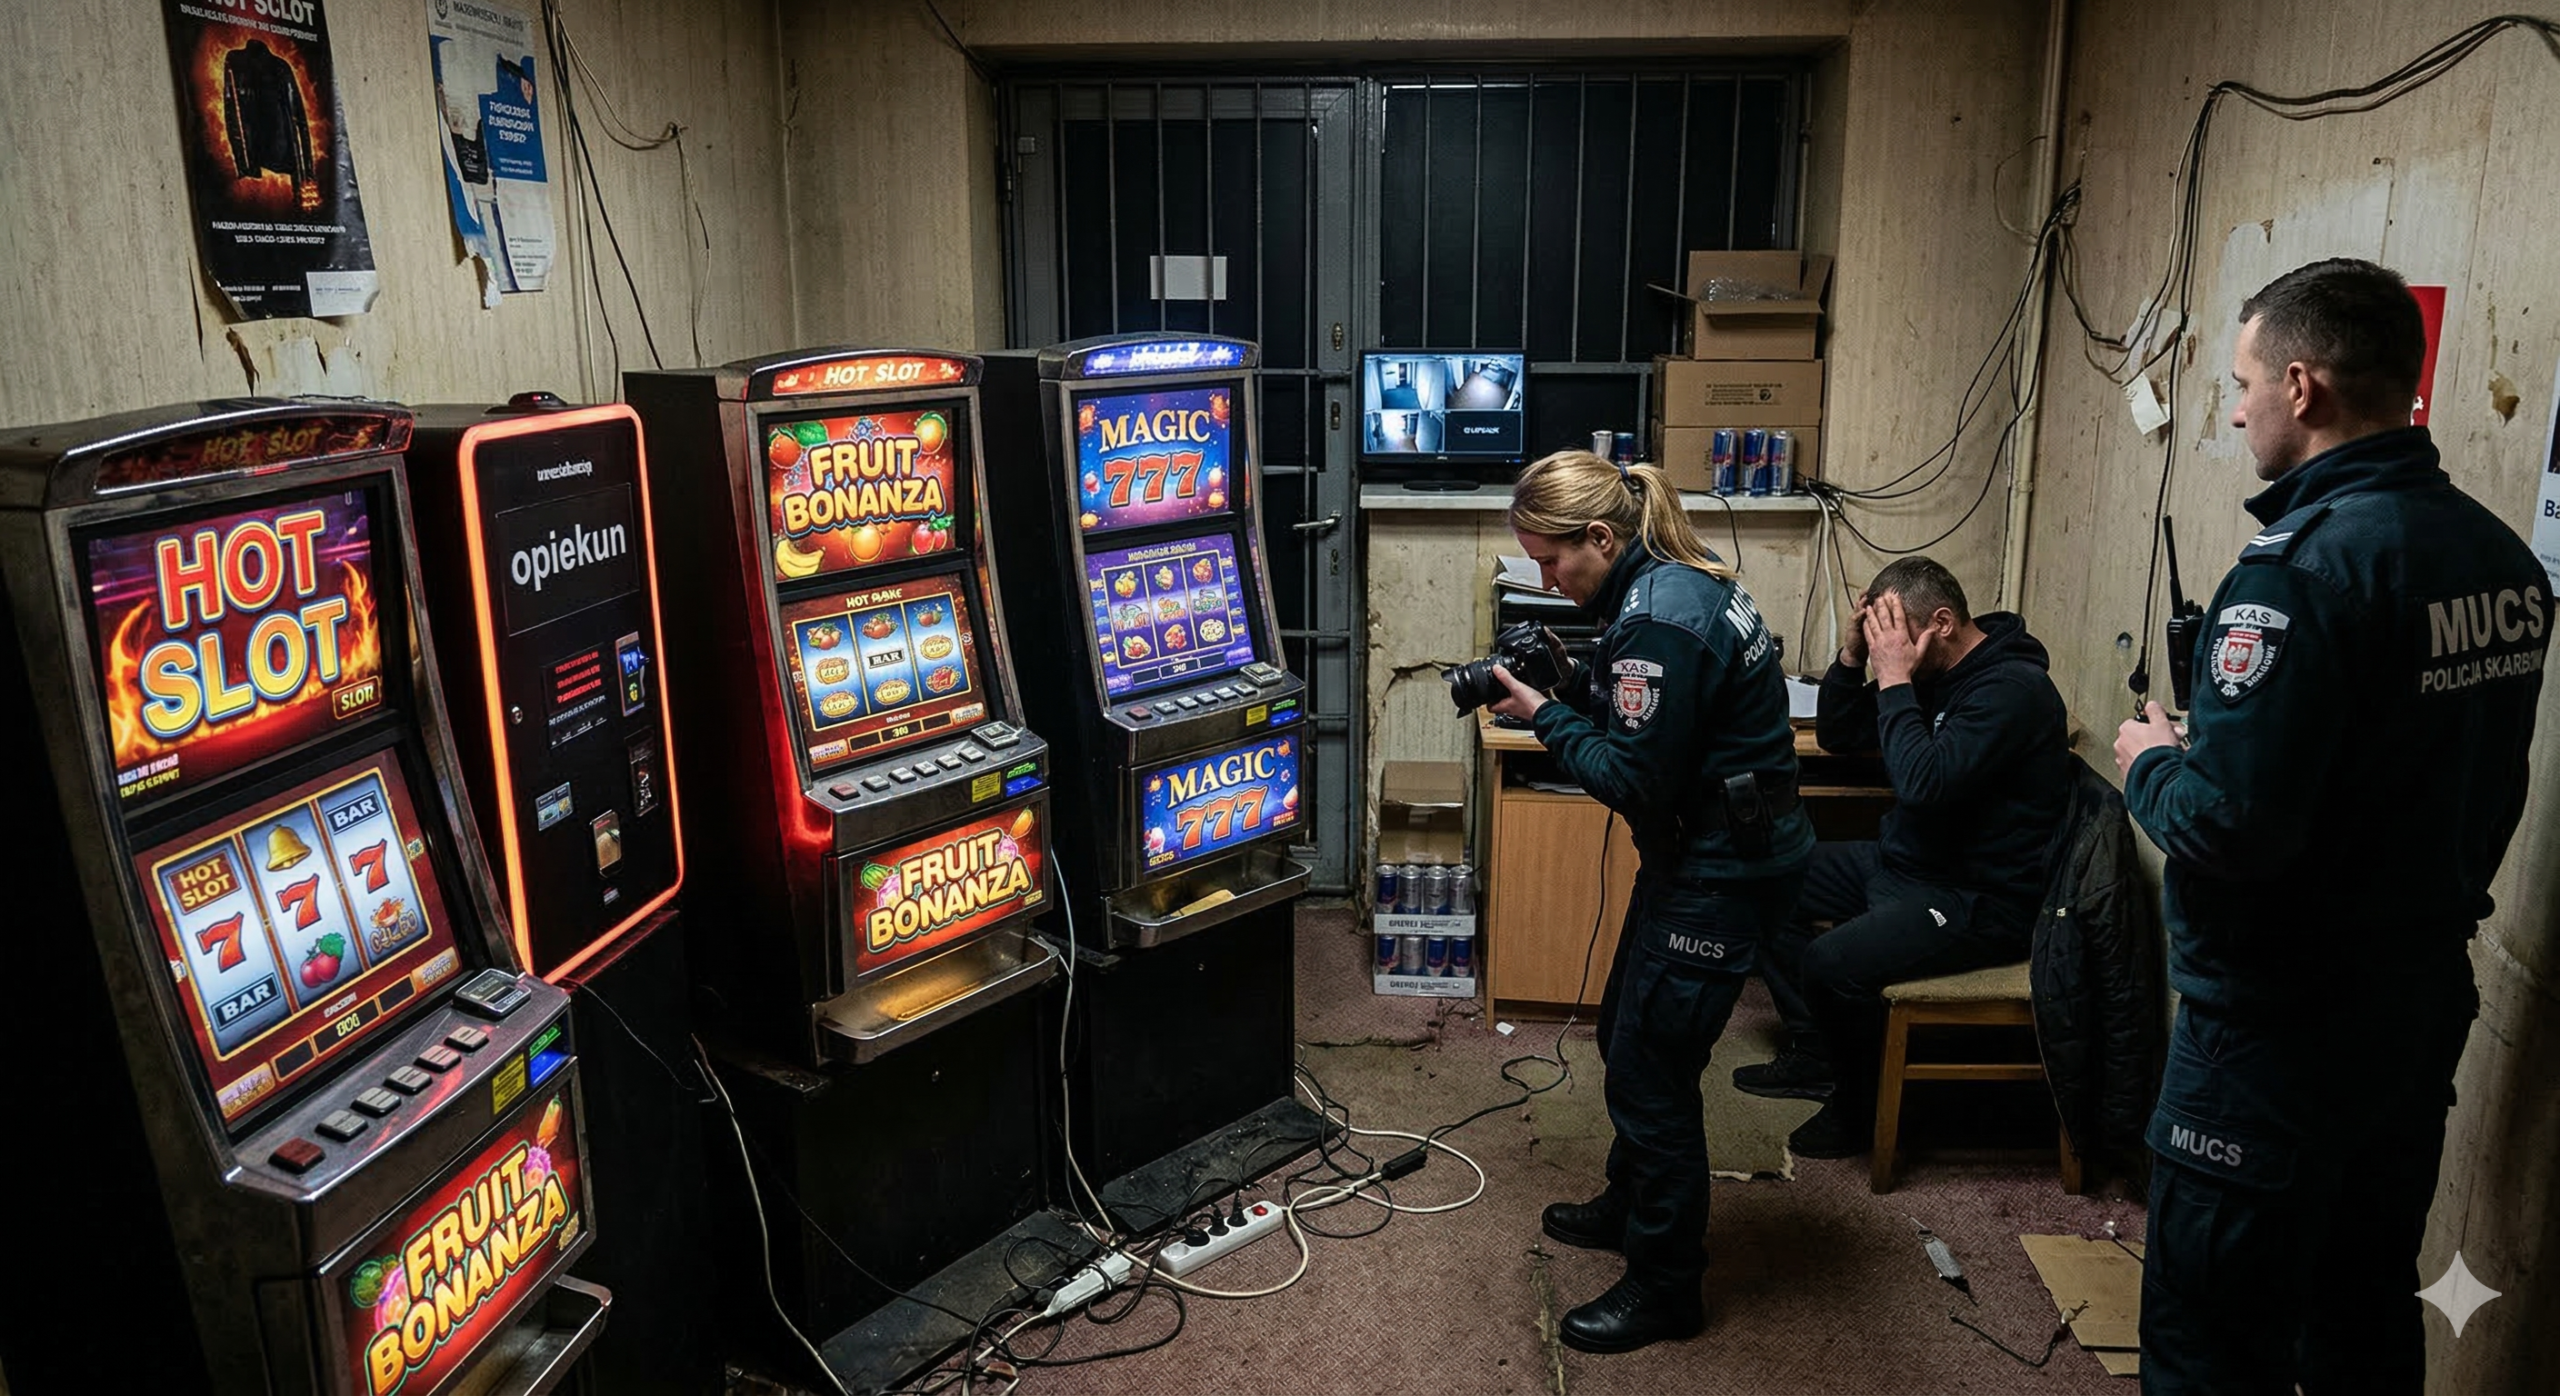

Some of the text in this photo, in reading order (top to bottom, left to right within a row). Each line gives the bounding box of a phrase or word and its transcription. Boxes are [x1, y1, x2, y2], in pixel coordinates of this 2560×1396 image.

[823, 362, 926, 385] HOT SLOT
[203, 425, 323, 464] HOT SLOT
[1099, 410, 1210, 453] MAGIC
[810, 438, 920, 487] FRUIT
[1104, 450, 1204, 508] 777
[783, 477, 945, 535] BONANZA
[157, 510, 325, 630] HOT
[511, 522, 626, 592] opiekun
[846, 594, 869, 608] HOT
[2235, 608, 2271, 625] KAS
[2428, 586, 2544, 658] MUCS
[142, 598, 346, 734] SLOT
[2421, 661, 2482, 693] POLICJA
[1167, 748, 1275, 808] MAGIC
[334, 799, 376, 828] BAR
[1176, 786, 1269, 851] 777
[179, 858, 221, 889] HOT
[181, 874, 231, 908] SLOT
[349, 838, 391, 894] 7
[901, 832, 1000, 897] FRUIT
[277, 873, 322, 931] 7
[870, 860, 1029, 948] BONANZA
[197, 912, 247, 972] 7
[1669, 933, 1725, 958] MUCS
[221, 983, 271, 1021] BAR
[2170, 1124, 2243, 1167] MUCS
[405, 1148, 528, 1298] FRUIT
[369, 1178, 566, 1396] BONANZA
